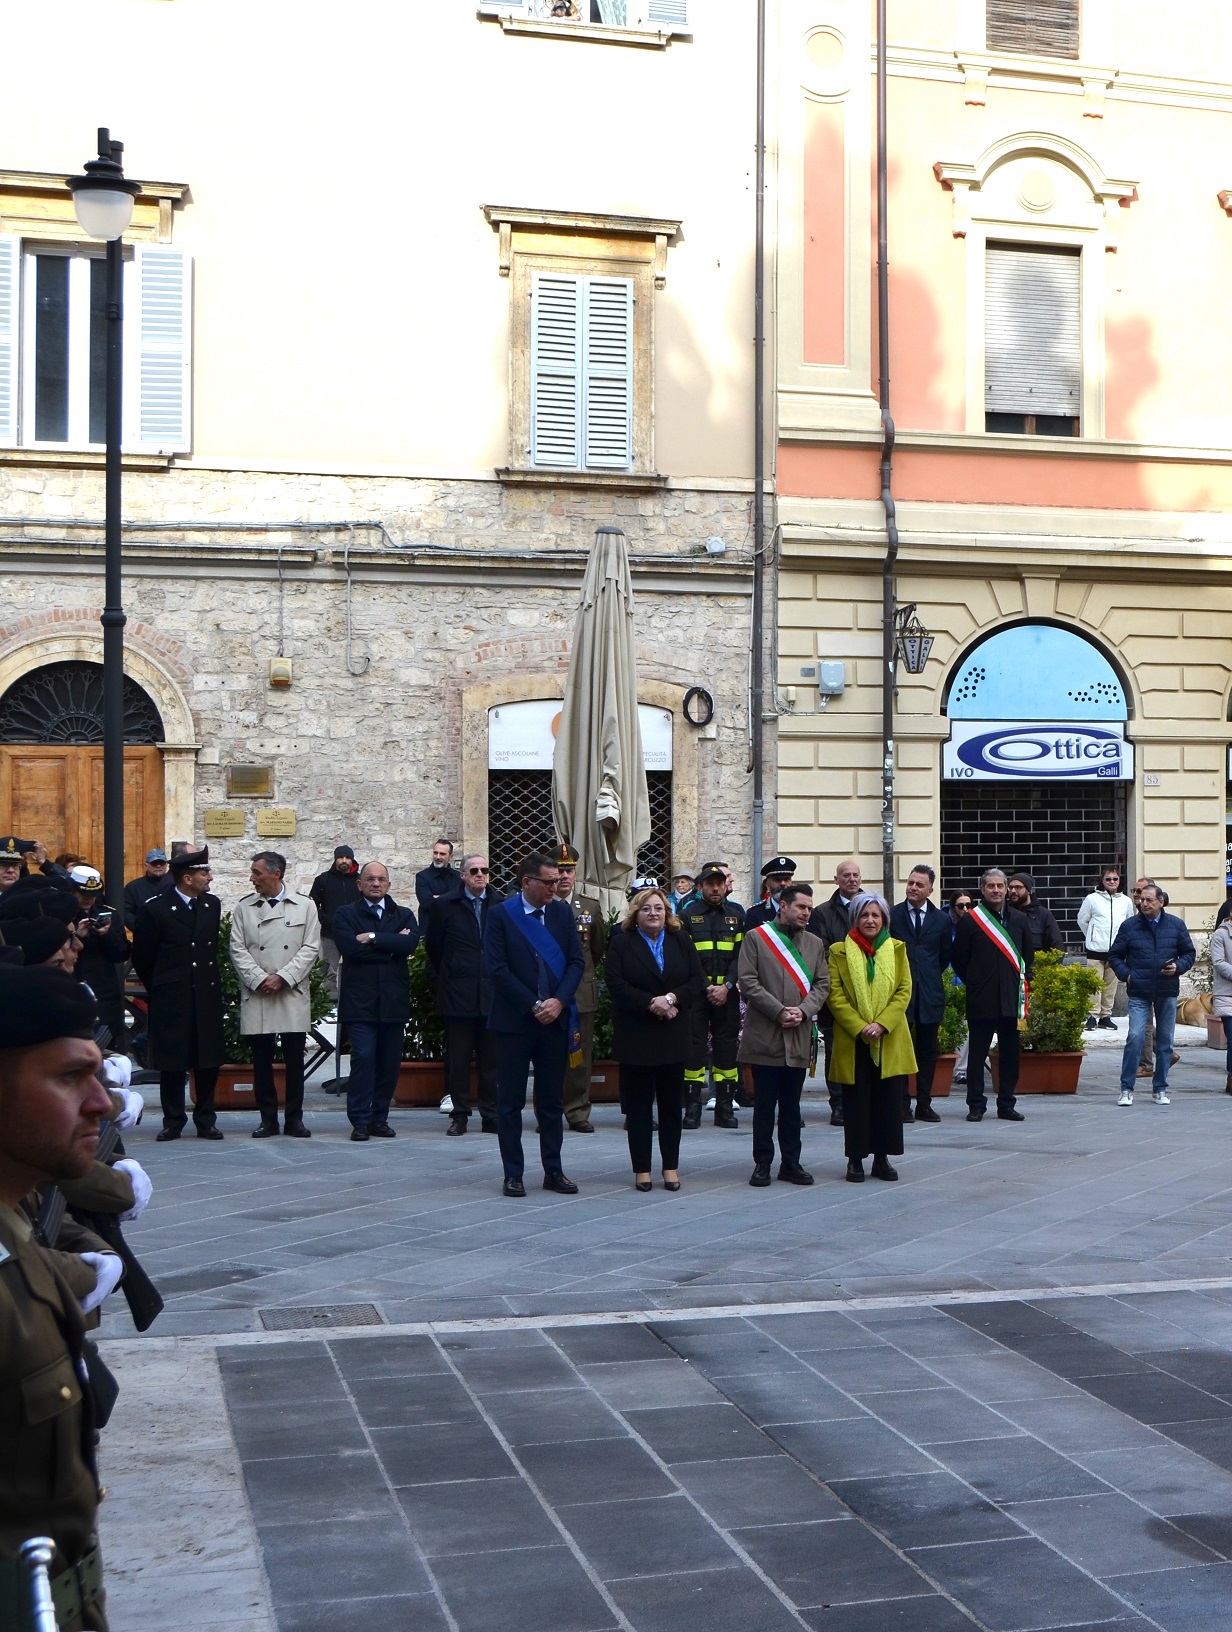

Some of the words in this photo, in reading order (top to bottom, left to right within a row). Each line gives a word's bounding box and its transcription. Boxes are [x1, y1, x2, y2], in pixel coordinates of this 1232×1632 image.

[908, 639, 917, 670] OTTICA
[950, 768, 974, 778] IVO
[1098, 767, 1118, 776] Galli
[1147, 775, 1158, 784] 85
